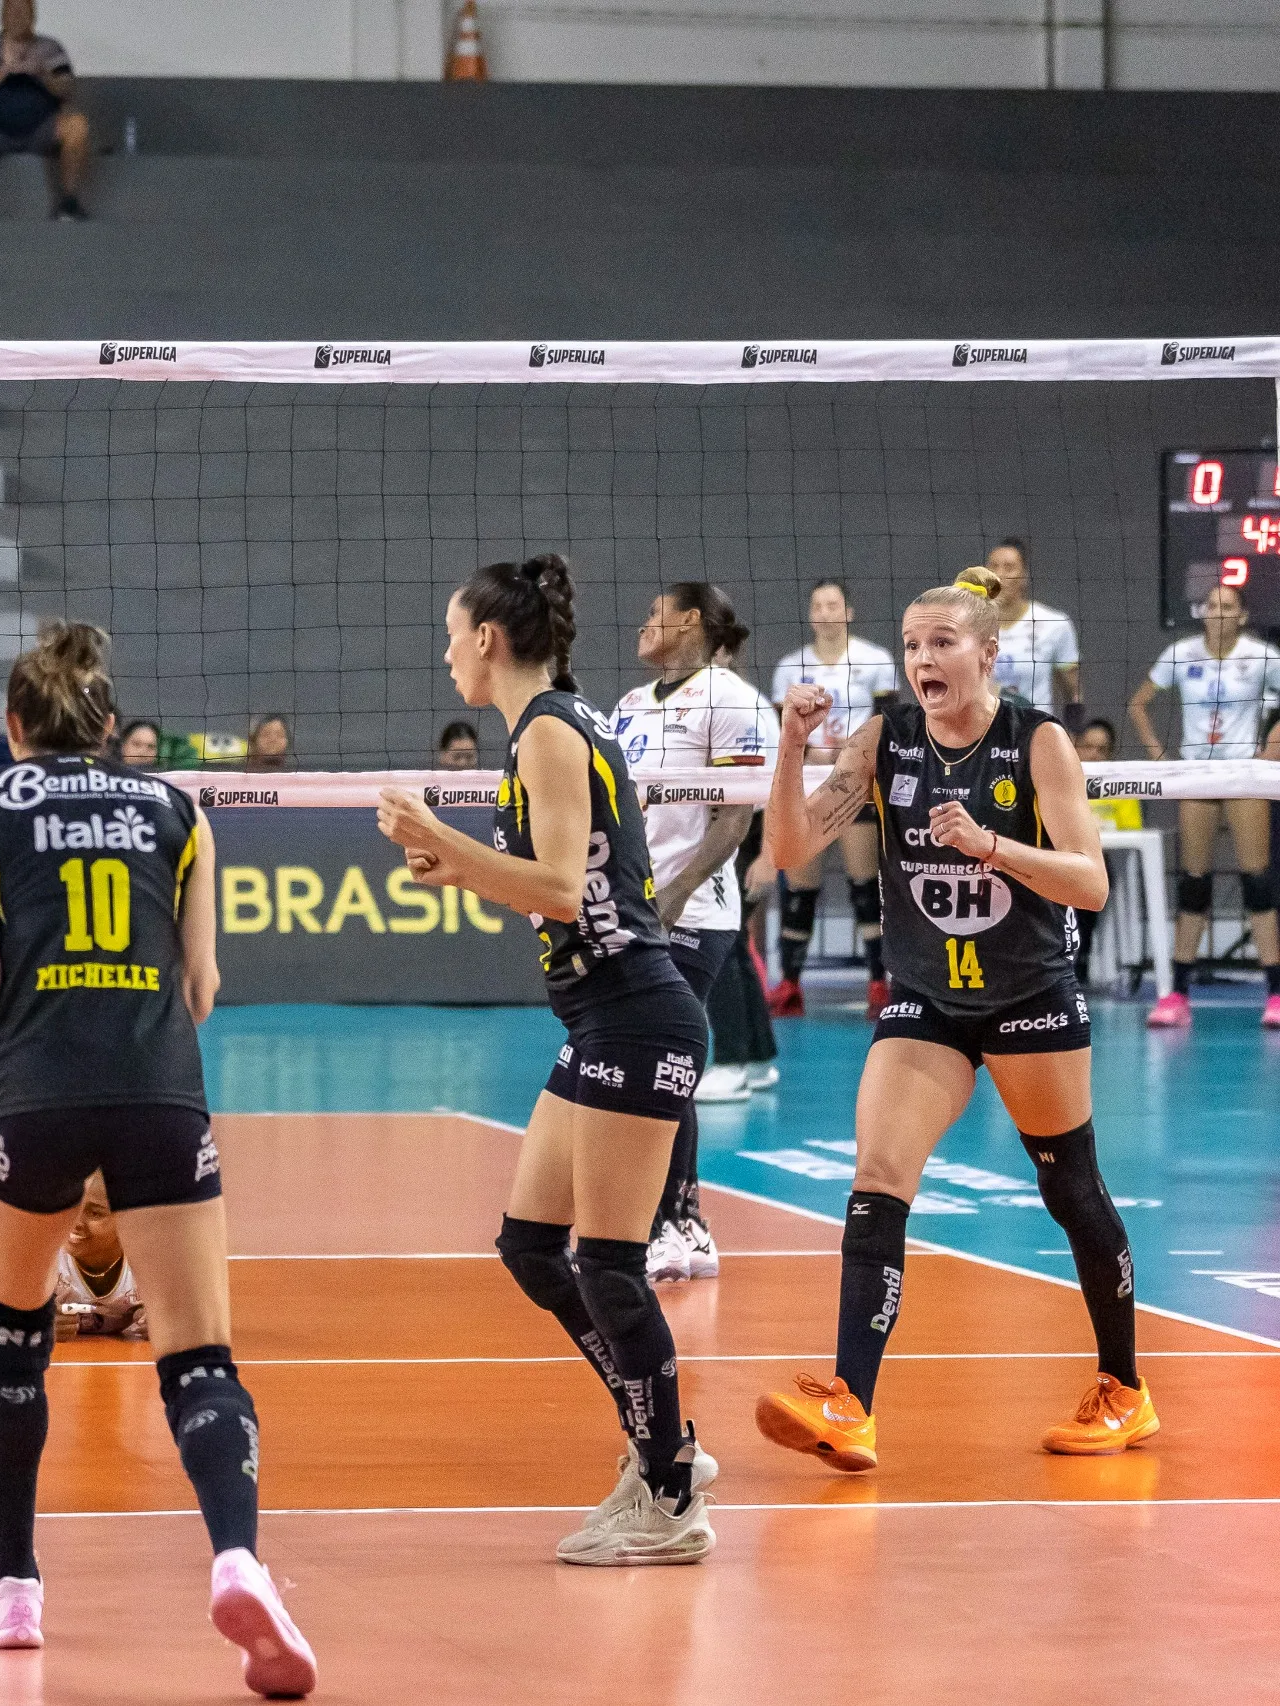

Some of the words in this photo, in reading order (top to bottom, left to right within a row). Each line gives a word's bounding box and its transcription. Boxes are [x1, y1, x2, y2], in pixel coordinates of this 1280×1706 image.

[118, 345, 177, 364] SUPERLIGA
[332, 346, 391, 366] SUPERLIGA
[546, 346, 605, 366] SUPERLIGA
[759, 345, 818, 365] SUPERLIGA
[970, 345, 1028, 365] SUPERLIGA
[1179, 344, 1235, 363] SUPERLIGA
[1193, 460, 1223, 504] 0
[217, 790, 279, 805] SUPERLIGA
[442, 790, 500, 806] SUPERLIG
[664, 788, 725, 803] SUPERLIGA
[1103, 782, 1162, 797] SUPERLIGA
[59, 858, 131, 952] 10
[919, 878, 993, 919] BH
[945, 937, 985, 989] 14
[35, 962, 160, 991] MICHELLE
[999, 1012, 1069, 1034] crock's
[655, 1061, 697, 1087] PRO
[871, 1266, 903, 1334] Dentil
[624, 1379, 644, 1440] Dentil
